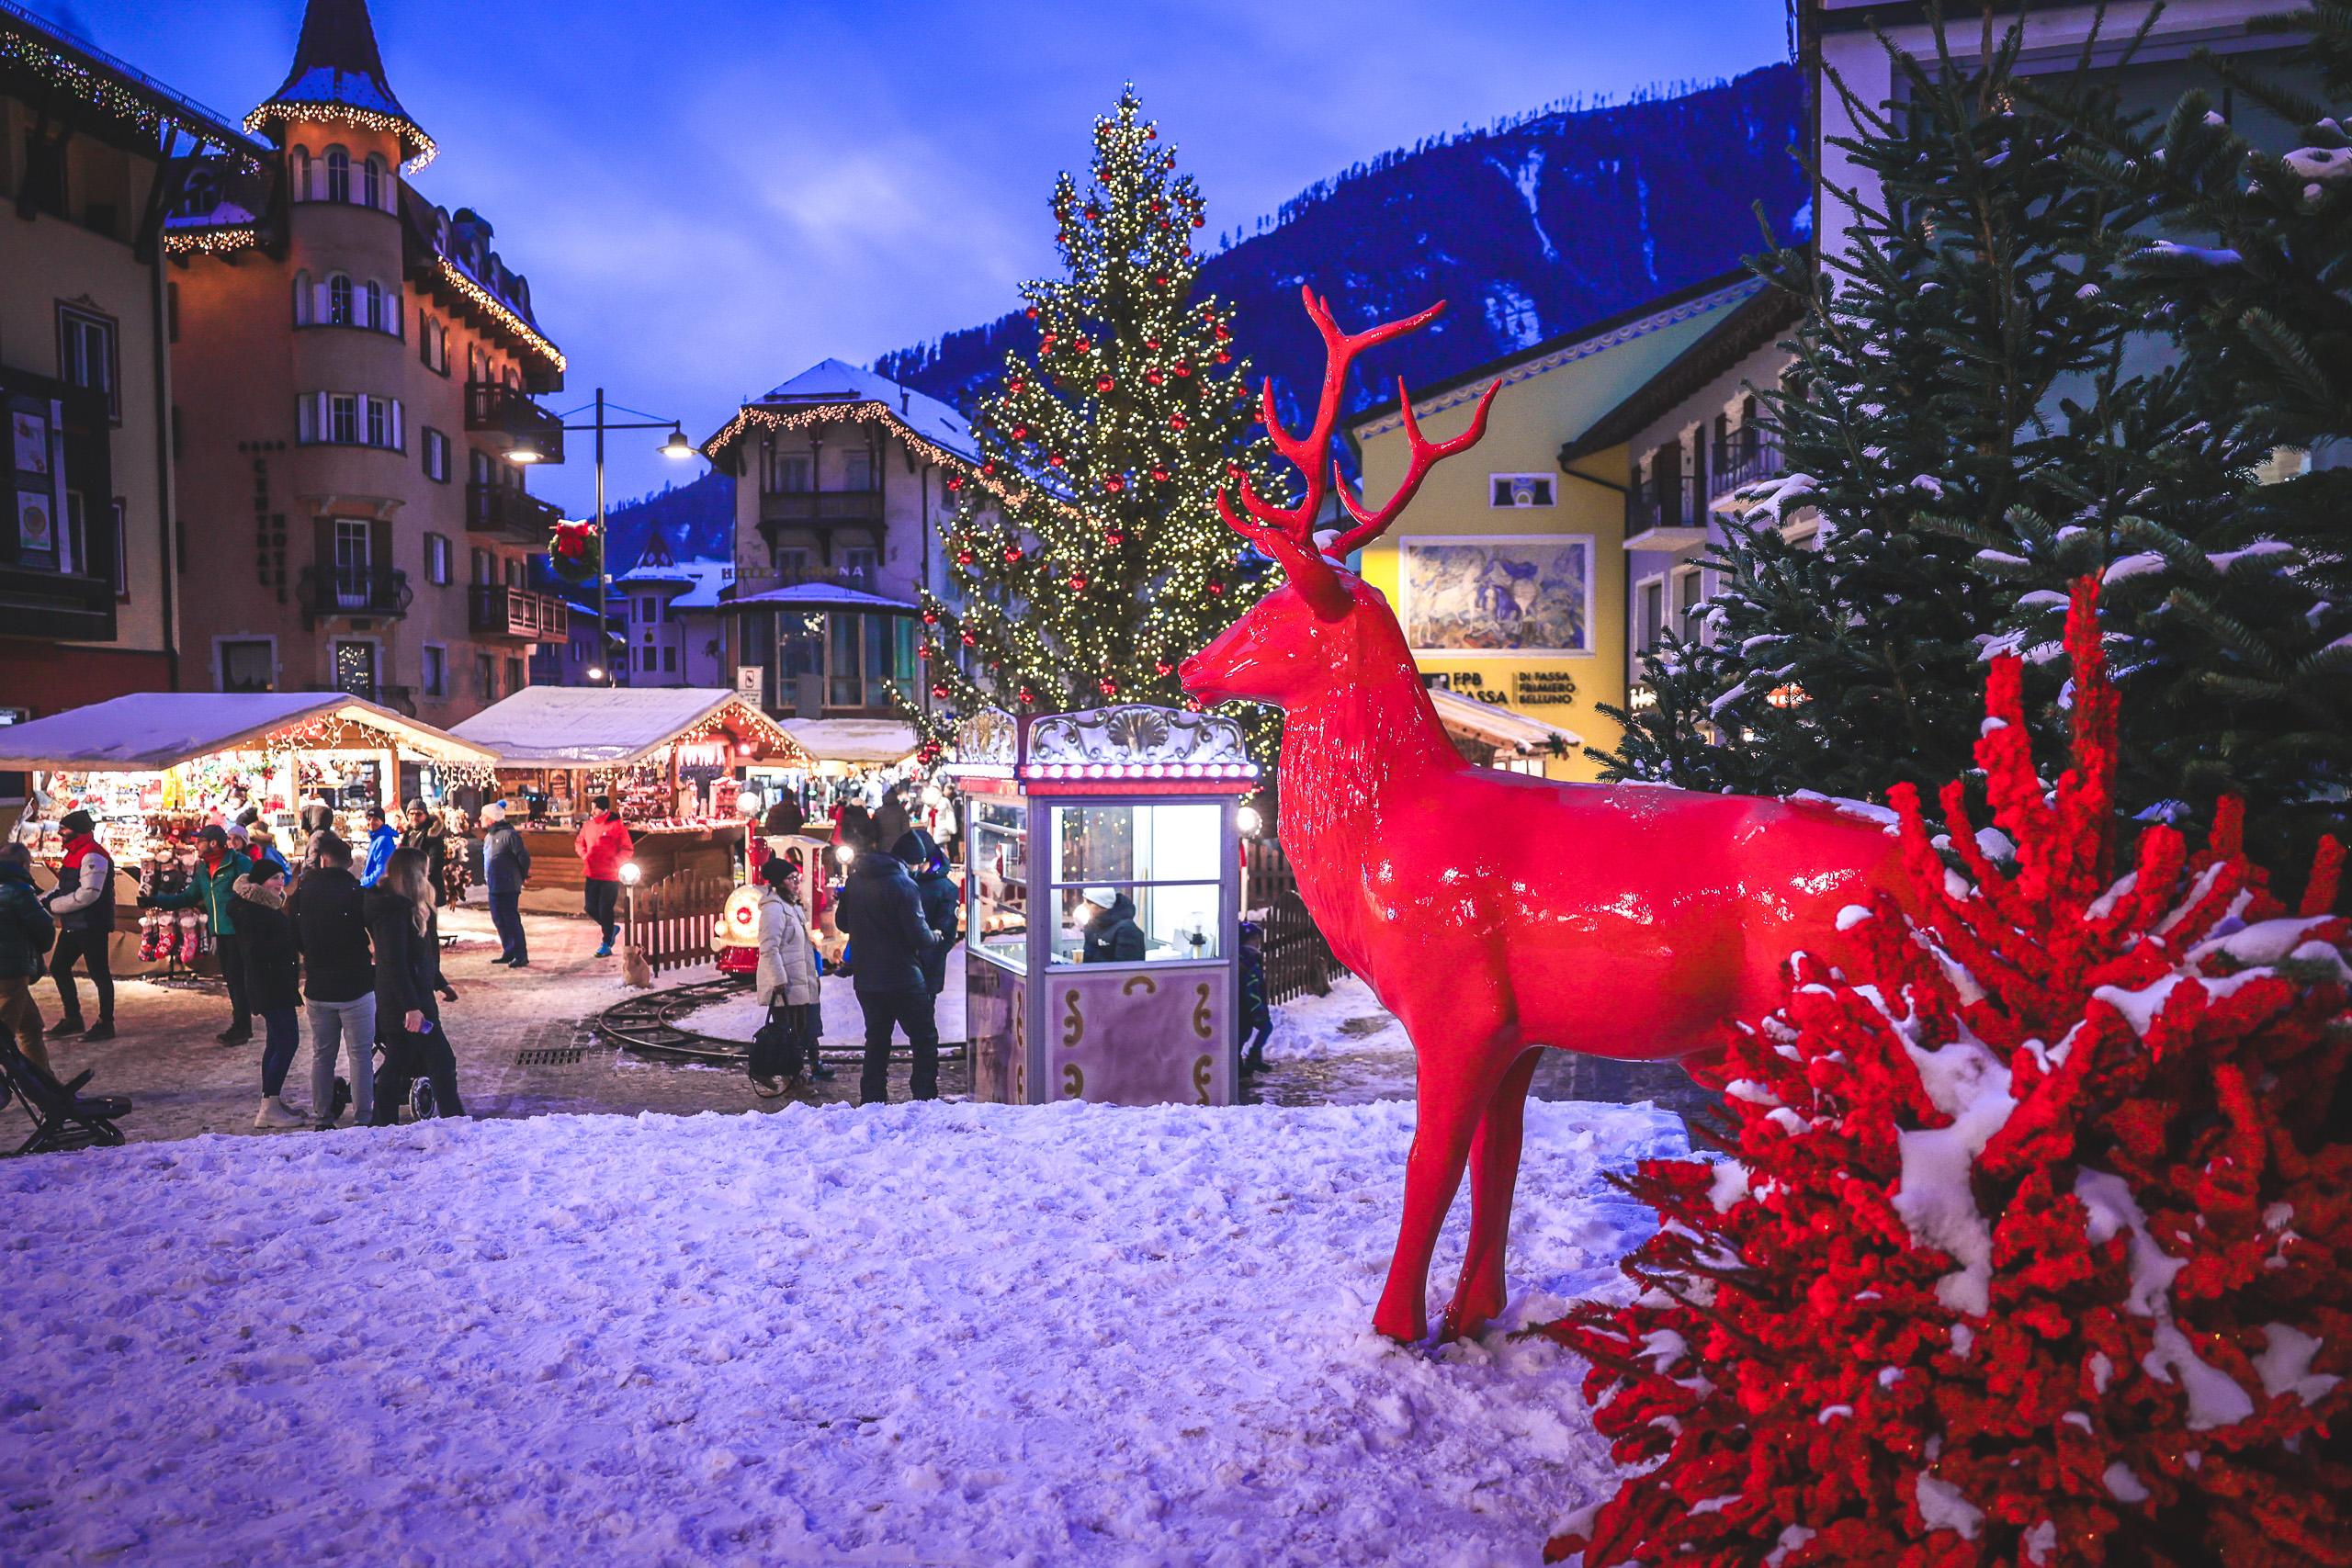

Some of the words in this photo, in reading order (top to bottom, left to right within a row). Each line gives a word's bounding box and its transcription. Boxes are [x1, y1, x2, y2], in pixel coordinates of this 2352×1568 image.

[1453, 672, 1482, 685] FPB
[1520, 672, 1532, 682] DI
[1535, 672, 1570, 682] FASSA
[1520, 683, 1576, 693] PRIMIERO
[1454, 690, 1508, 704] ASSA
[1520, 694, 1572, 705] BELLUNO
